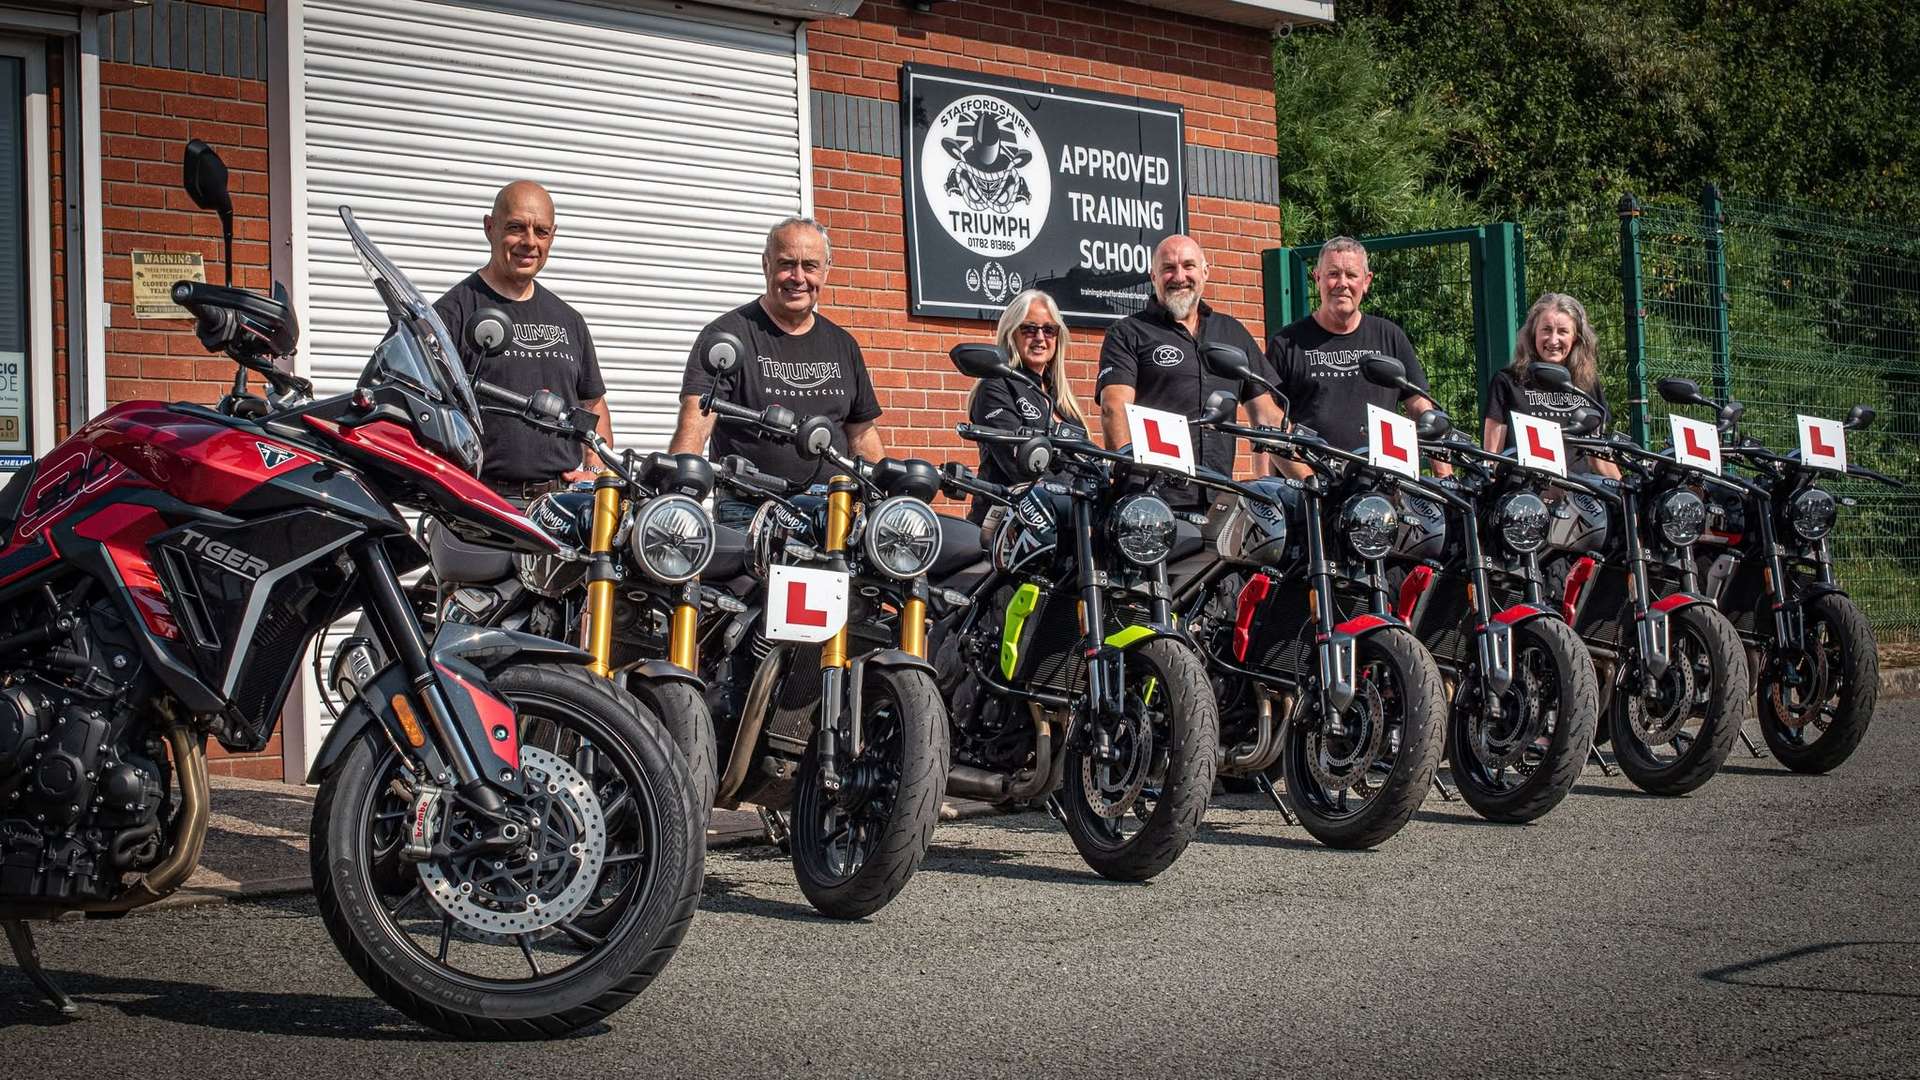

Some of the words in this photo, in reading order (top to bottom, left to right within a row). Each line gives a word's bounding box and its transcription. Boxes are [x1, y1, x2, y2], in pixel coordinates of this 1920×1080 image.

[940, 99, 1031, 138] STAFFORDSHIRE
[1060, 144, 1169, 186] APPROVED
[949, 210, 1031, 239] TRIUMPH
[1068, 191, 1163, 230] TRAINING
[143, 253, 192, 264] WARNING
[968, 237, 989, 248] 01782
[512, 323, 569, 349] IUMPH
[504, 350, 574, 361] OTORCYCLES
[757, 355, 842, 387] TRIUMPH
[765, 387, 845, 396] MOTORCYCLES
[1143, 418, 1181, 458] L
[1380, 420, 1408, 463] L
[1526, 425, 1556, 462] L
[1683, 427, 1711, 461] L
[1809, 425, 1836, 457] L
[1020, 496, 1050, 534] RIUMPH
[181, 529, 269, 577] TIGER
[786, 581, 827, 627] L
[415, 801, 428, 838] brembo
